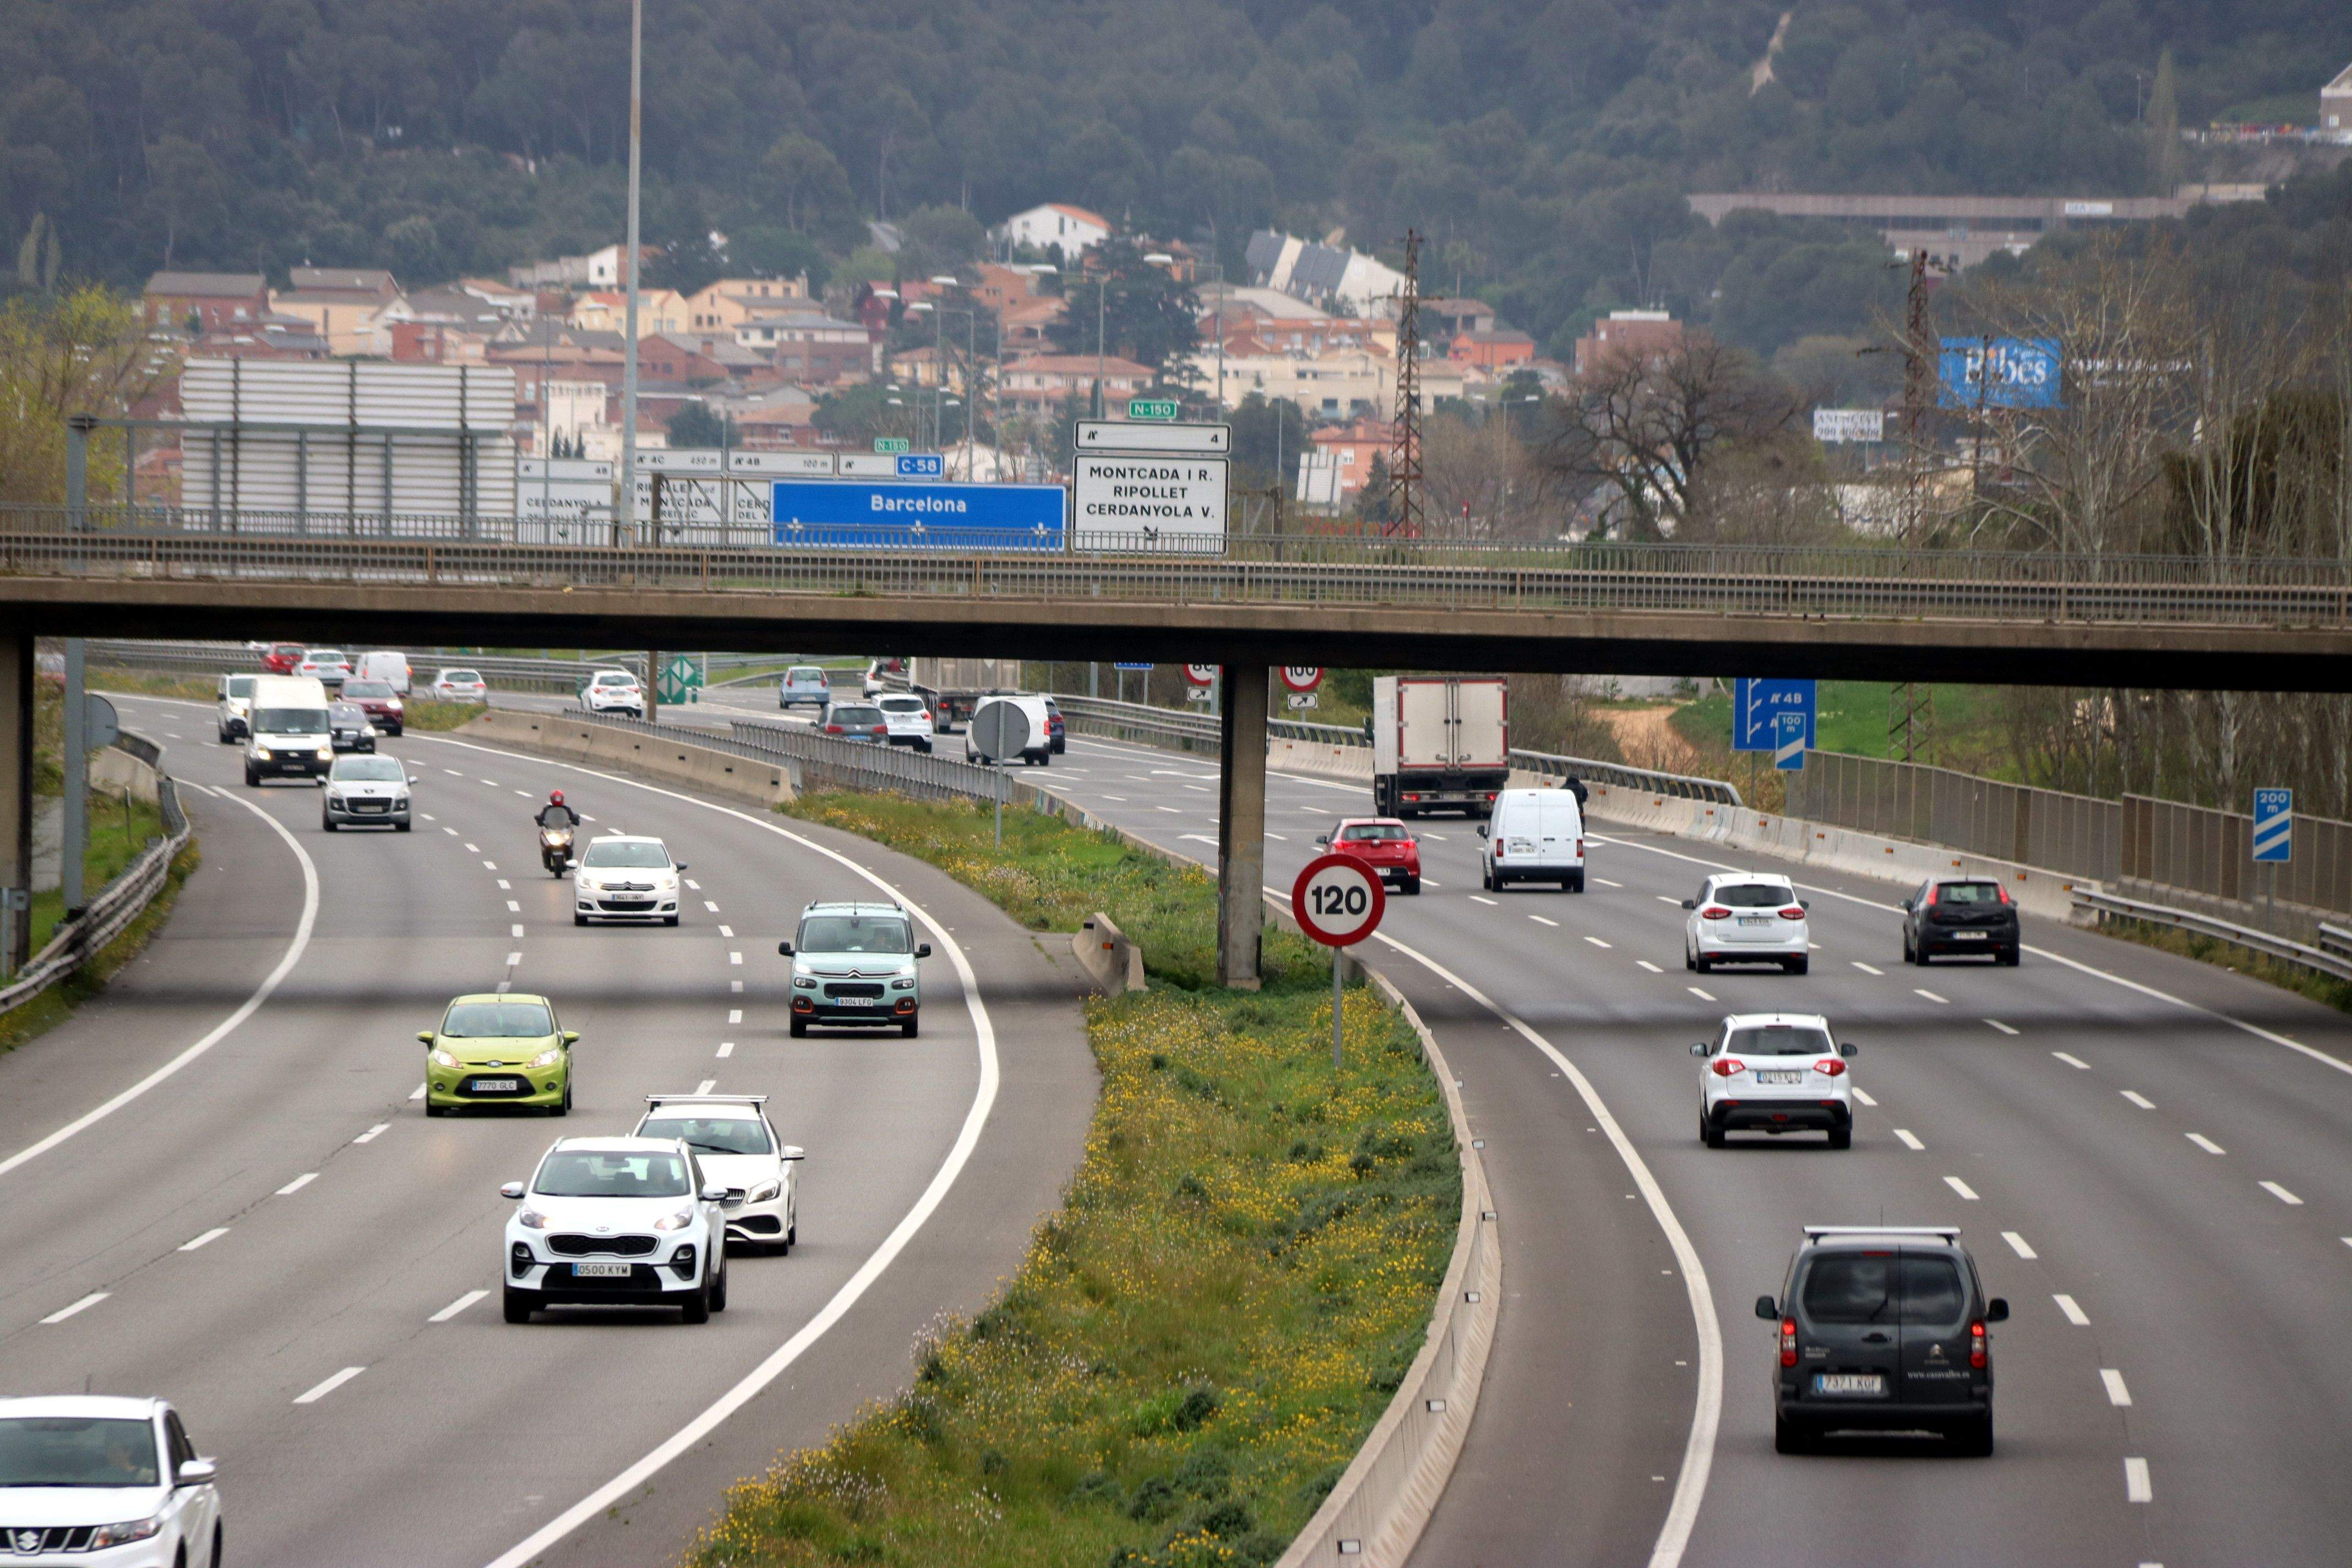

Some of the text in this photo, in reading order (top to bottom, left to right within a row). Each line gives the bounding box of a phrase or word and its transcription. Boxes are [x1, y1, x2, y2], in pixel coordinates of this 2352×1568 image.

[1135, 404, 1172, 415] N-150
[1211, 434, 1218, 443] 4
[901, 459, 937, 472] C-58
[1090, 466, 1212, 481] MONTCADA I R.
[1114, 486, 1188, 499] RIPOLLET
[871, 494, 966, 513] Barcelona
[1086, 503, 1215, 519] CERDANYOLA V.
[1784, 693, 1802, 704] 4B
[1783, 716, 1800, 725] 100
[2260, 793, 2287, 803] 200
[2267, 805, 2279, 813] m
[1311, 885, 1366, 915] 120
[579, 1265, 628, 1275] 0500 KYM
